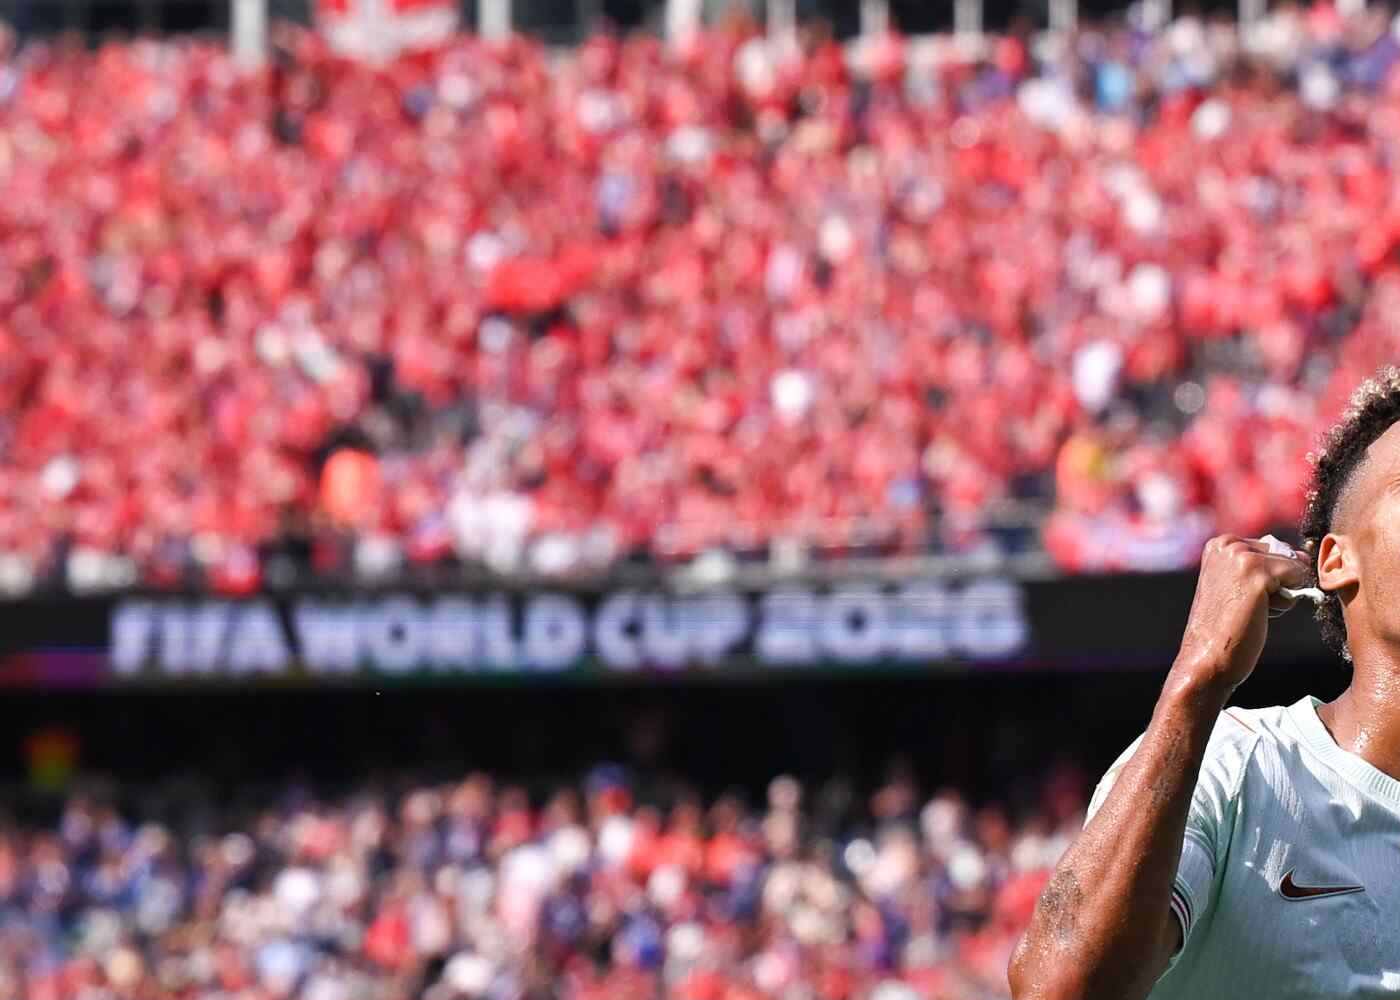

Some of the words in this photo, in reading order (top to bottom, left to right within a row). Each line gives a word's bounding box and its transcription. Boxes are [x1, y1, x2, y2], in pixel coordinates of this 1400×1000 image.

[111, 600, 293, 675] FIFA
[297, 595, 585, 673] WORLD
[598, 588, 751, 669] CUP
[753, 576, 1029, 665] 2026
